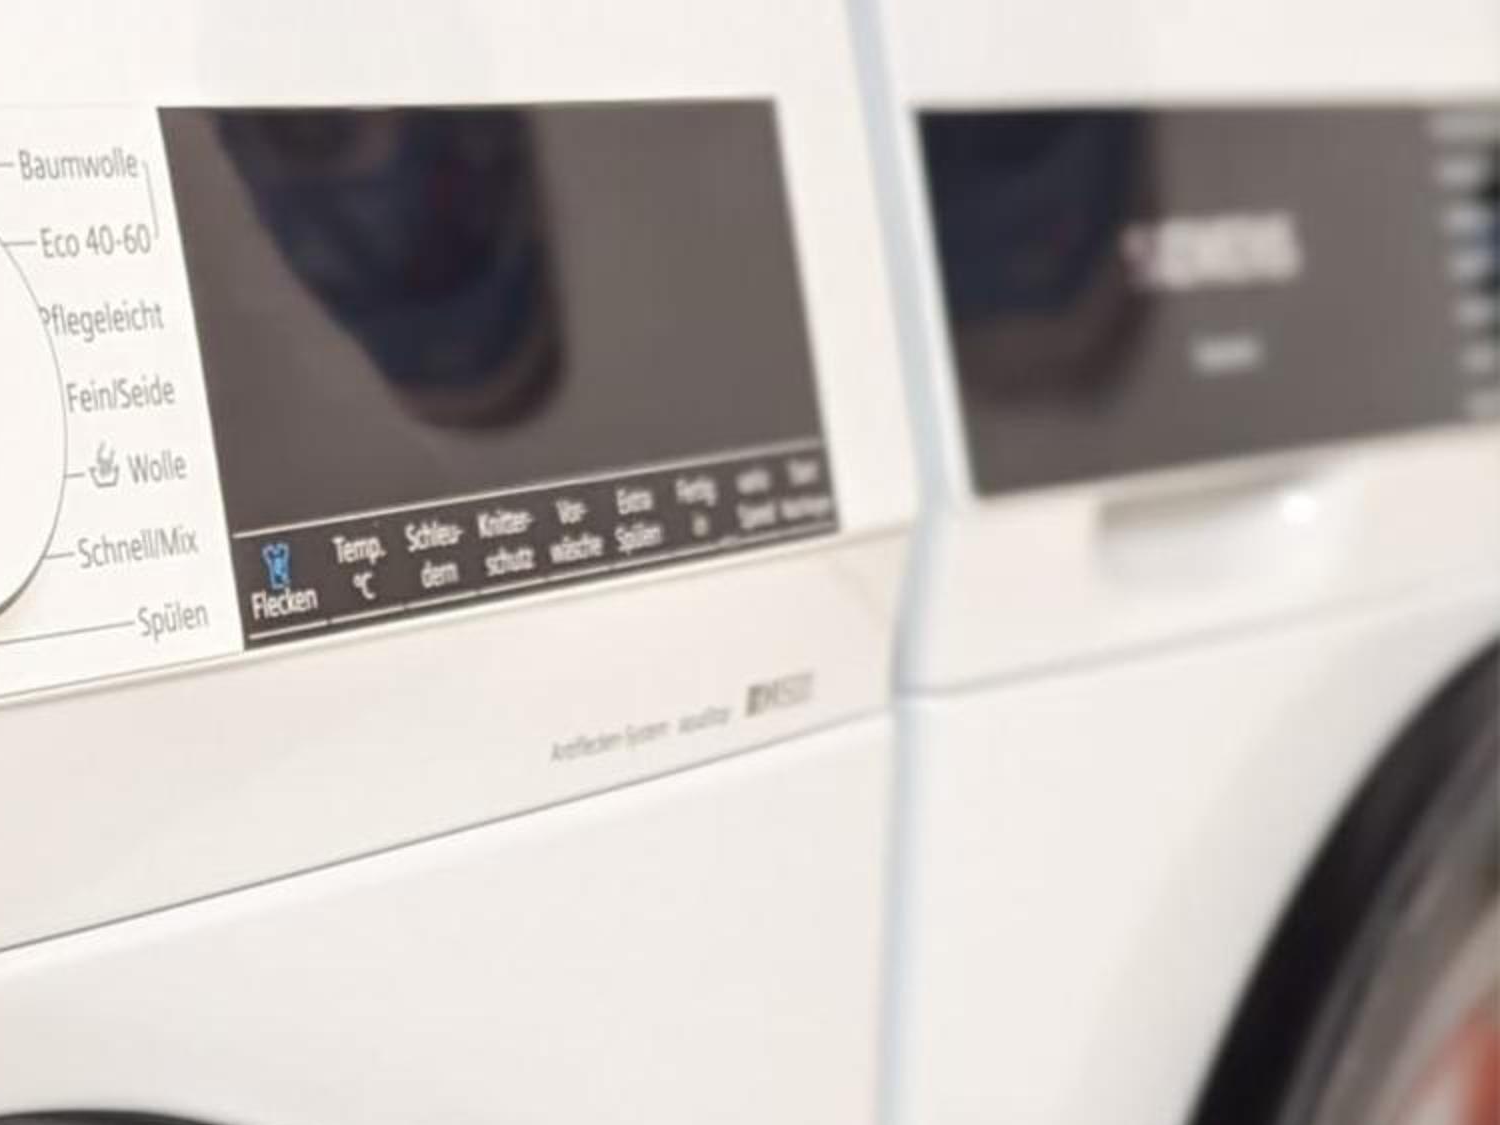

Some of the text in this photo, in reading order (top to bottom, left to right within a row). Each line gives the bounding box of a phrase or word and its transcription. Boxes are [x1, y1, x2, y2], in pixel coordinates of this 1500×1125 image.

[18, 148, 140, 181] Baumwolle
[40, 223, 152, 258] Eco 40-60
[66, 374, 176, 413] Fein/Seide
[126, 449, 187, 484] Wolle
[76, 524, 199, 569] Schnell/Mix
[333, 535, 387, 565] Temp.
[137, 602, 210, 641] Spülen
[251, 588, 319, 620] Flecken
